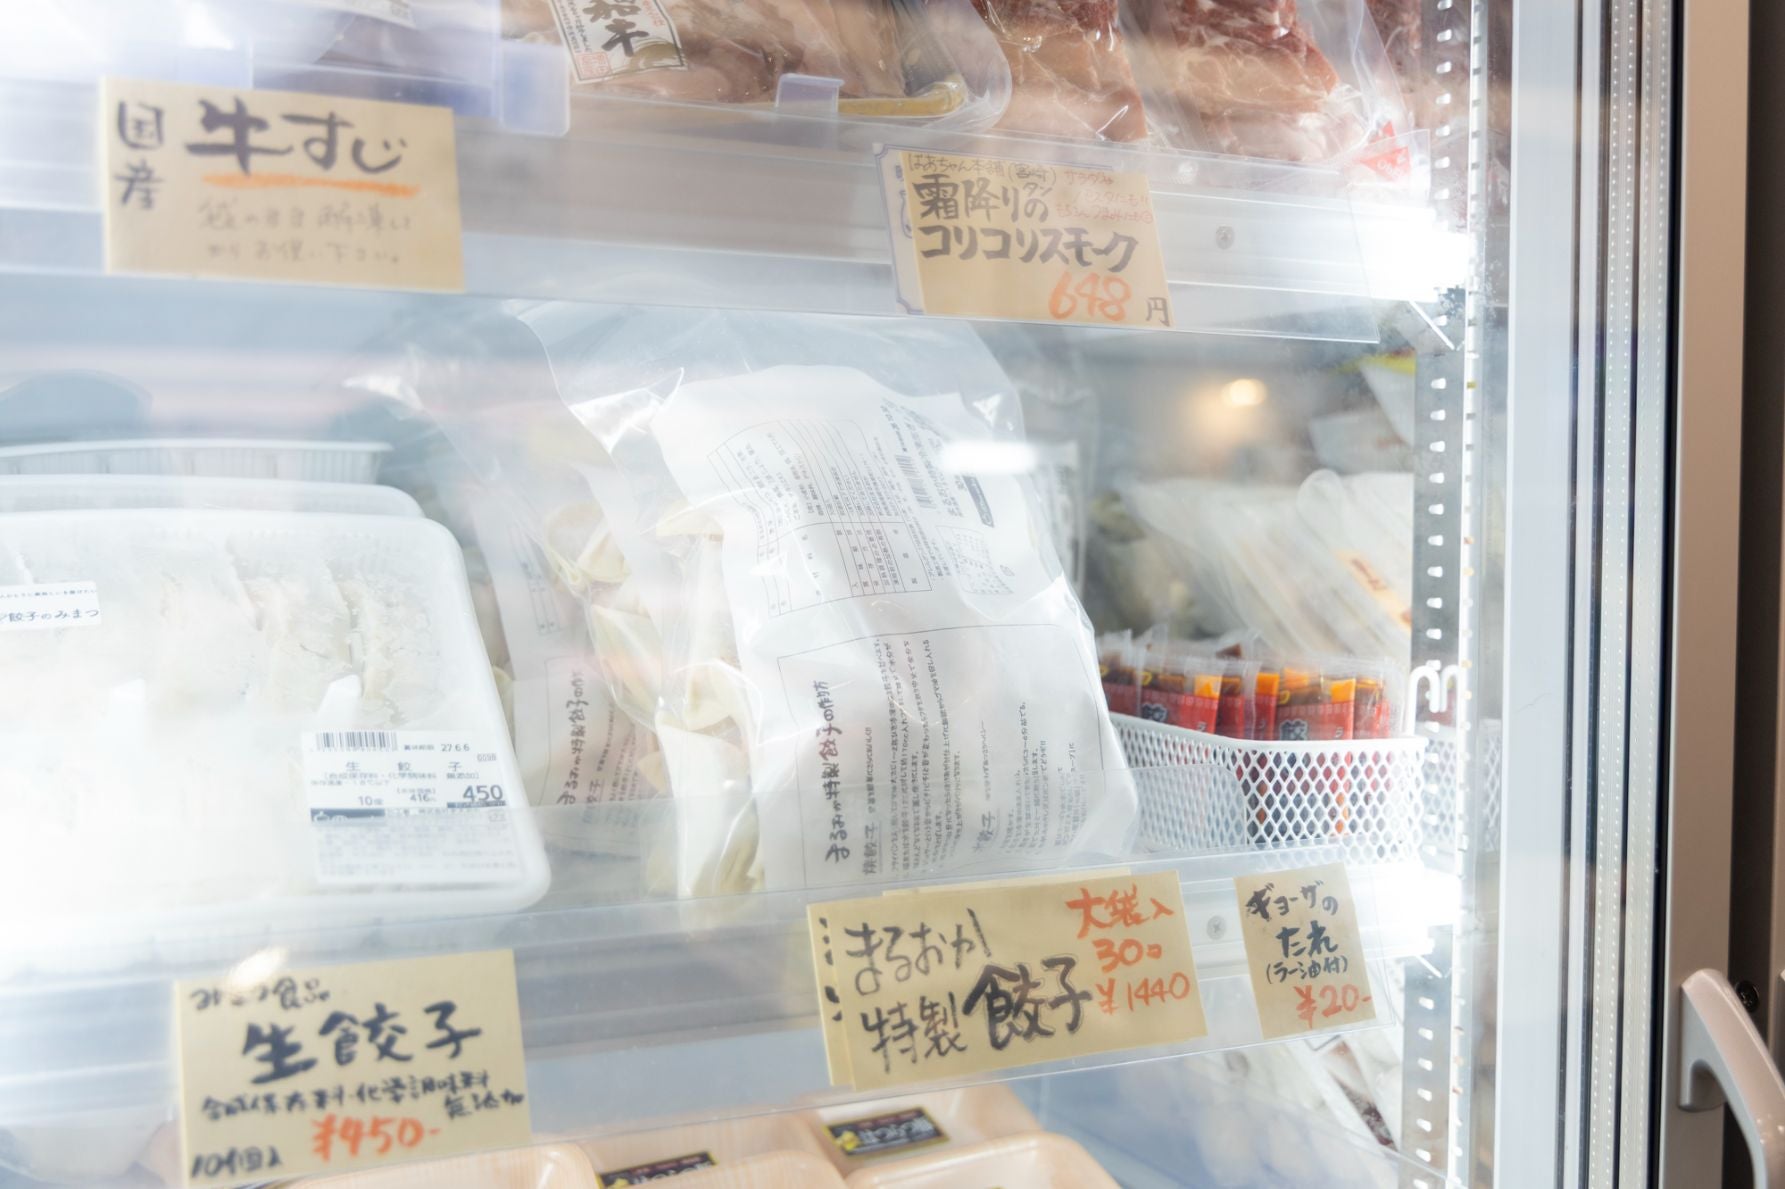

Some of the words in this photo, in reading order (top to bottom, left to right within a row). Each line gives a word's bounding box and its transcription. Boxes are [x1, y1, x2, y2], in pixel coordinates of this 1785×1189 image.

[114, 99, 165, 210] 国産
[184, 96, 408, 176] 牛すじ
[912, 174, 1049, 222] 霜降りの
[918, 225, 1139, 273] コリコリスモーク
[1049, 271, 1132, 322] 648
[1145, 296, 1171, 327] 円
[462, 784, 504, 801] 450
[1245, 879, 1340, 922] ギョーザの
[844, 907, 993, 996] まるおか
[1275, 920, 1339, 959] たれ
[1095, 971, 1191, 1015] ¥1440
[1266, 956, 1349, 985] (ラー油付)
[860, 956, 1093, 1074] 特製餃子
[241, 1001, 483, 1085] 生餃子
